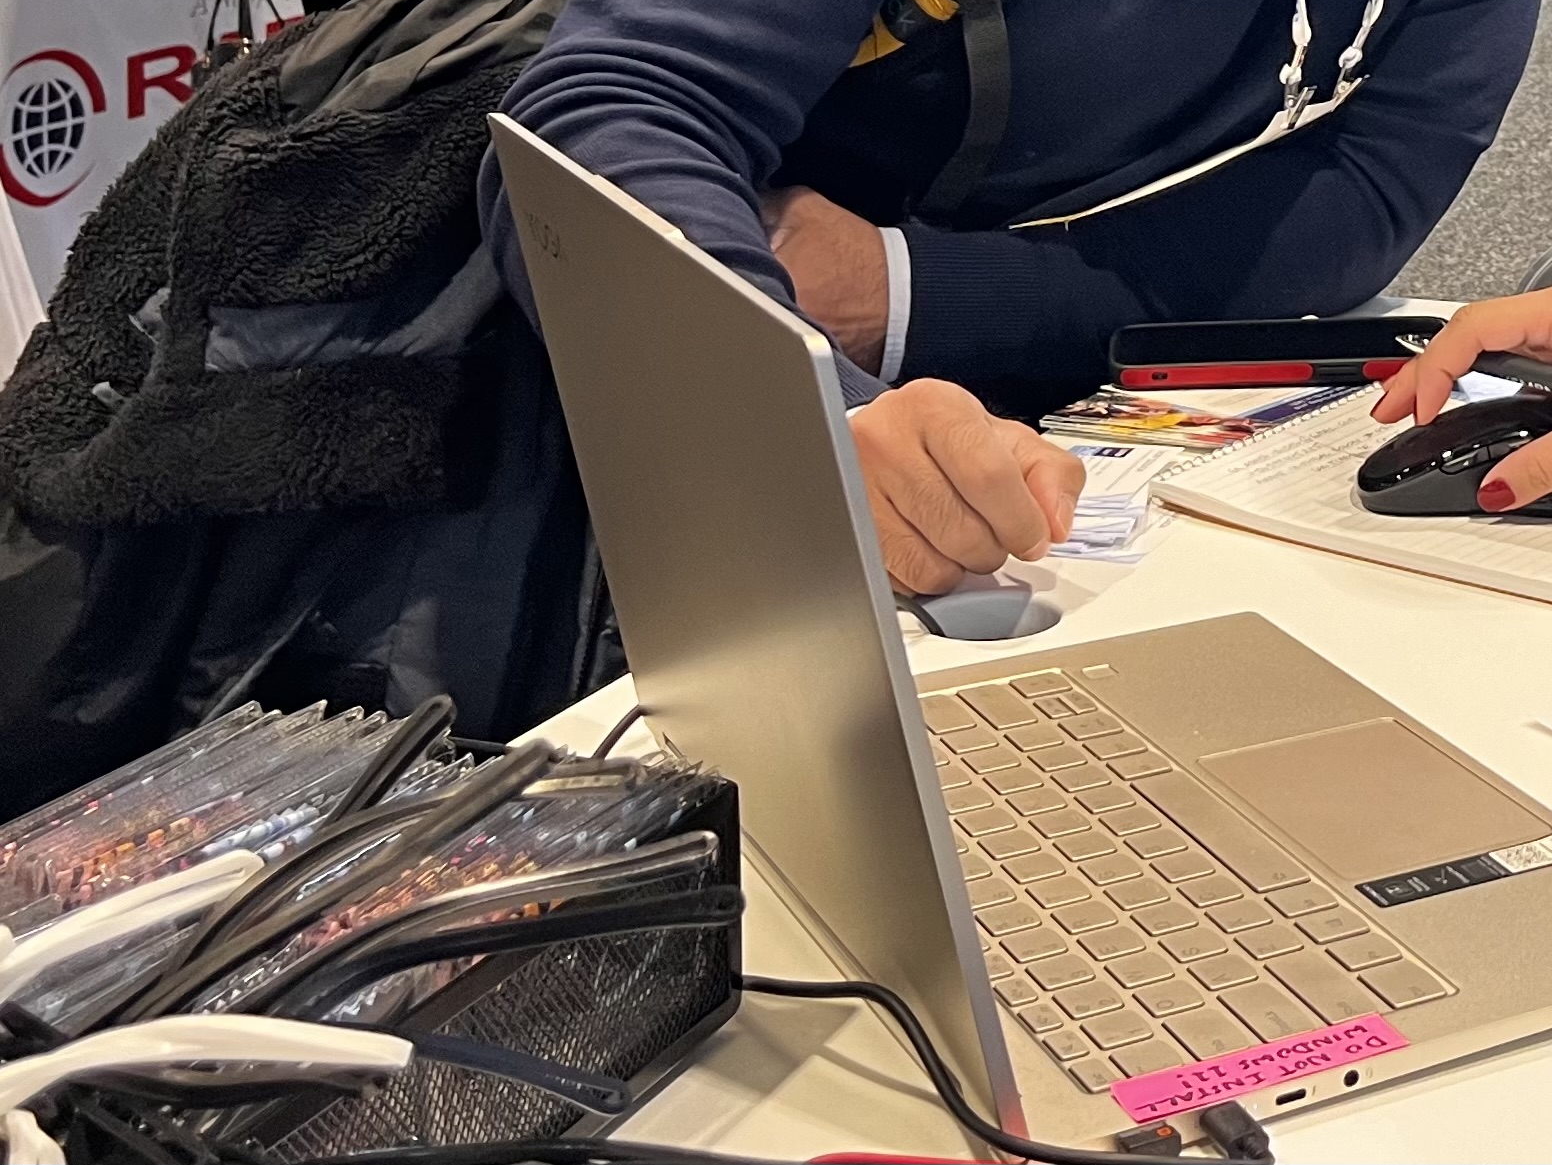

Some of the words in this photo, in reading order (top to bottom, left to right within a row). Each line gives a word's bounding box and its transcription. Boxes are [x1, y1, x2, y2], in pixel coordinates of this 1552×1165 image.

[1238, 1024, 1369, 1070] WINDOWS
[1345, 1035, 1388, 1054] DO
[1279, 1053, 1331, 1077] NOT
[1134, 1071, 1267, 1112] INSTALL
